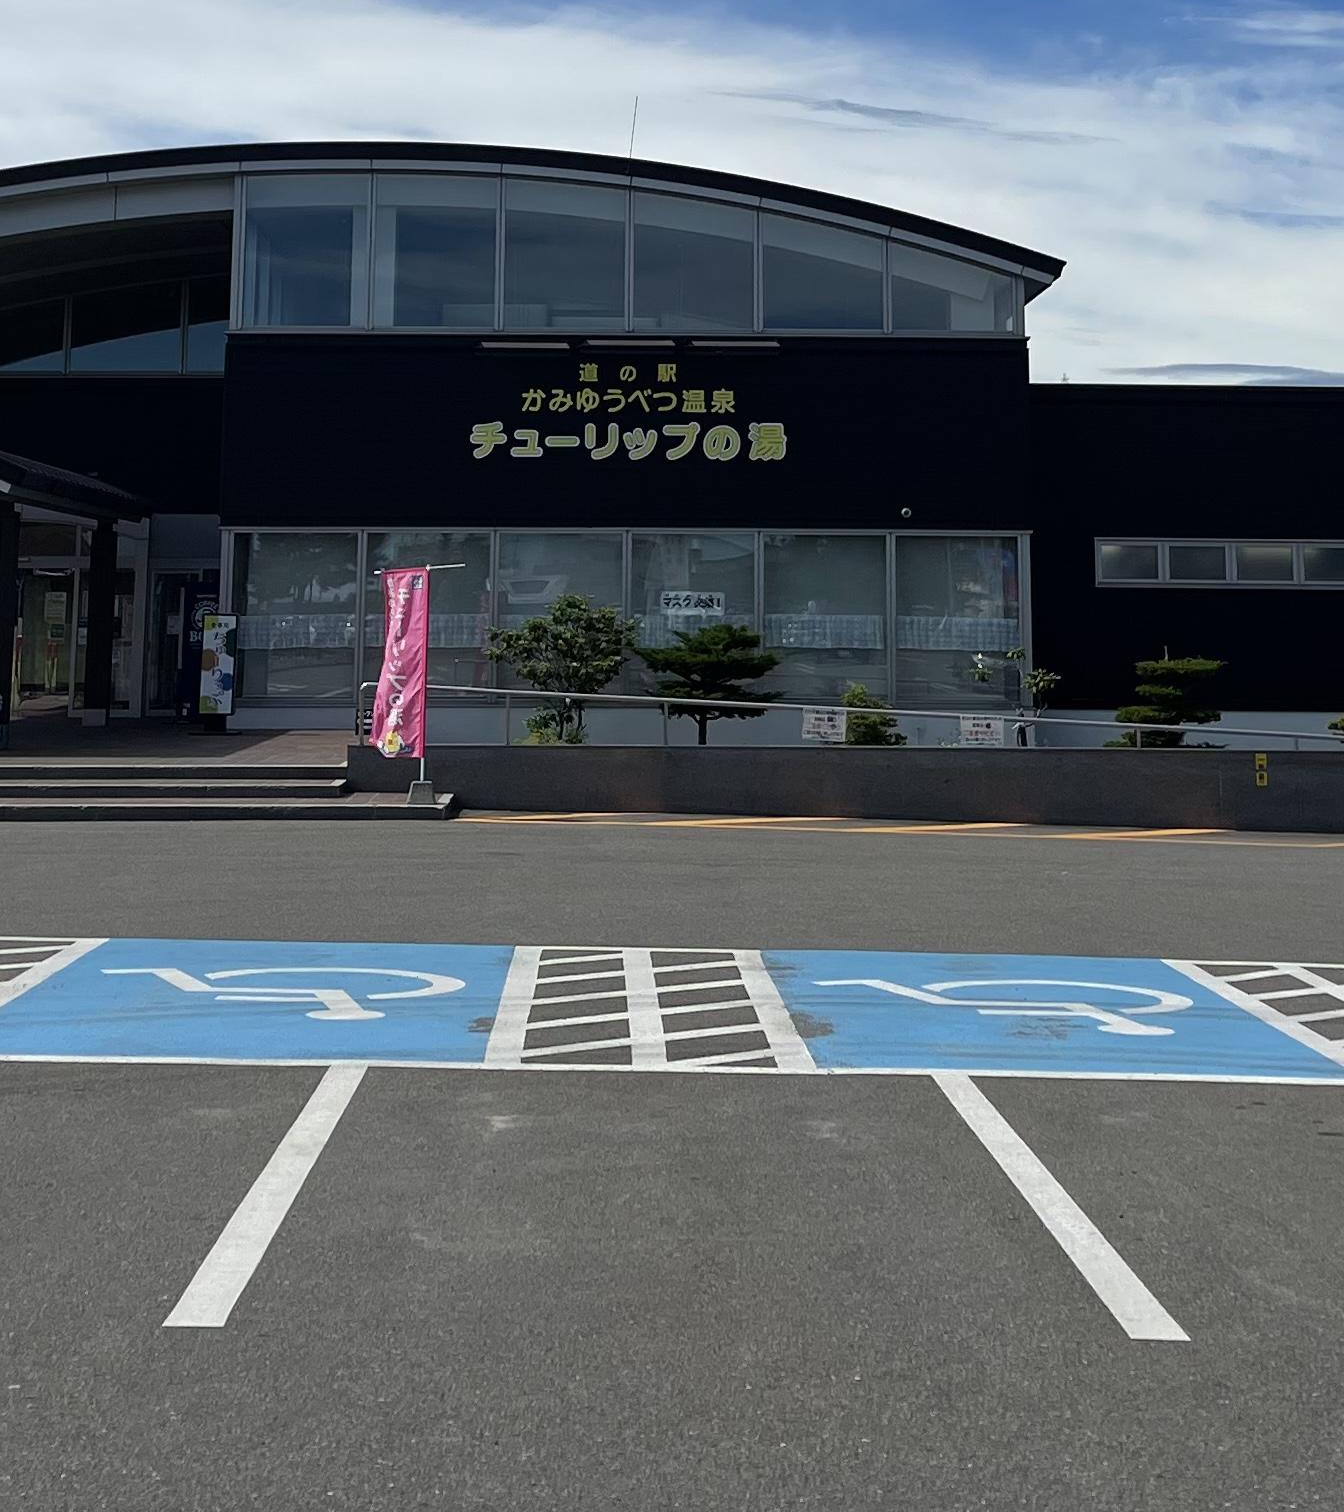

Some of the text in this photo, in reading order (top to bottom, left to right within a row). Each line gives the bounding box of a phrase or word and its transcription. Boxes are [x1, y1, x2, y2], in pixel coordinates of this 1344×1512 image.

[578, 363, 678, 383] 道の駅
[521, 388, 736, 413] かみゆうべつ温泉
[469, 421, 788, 461] チューリップの湯
